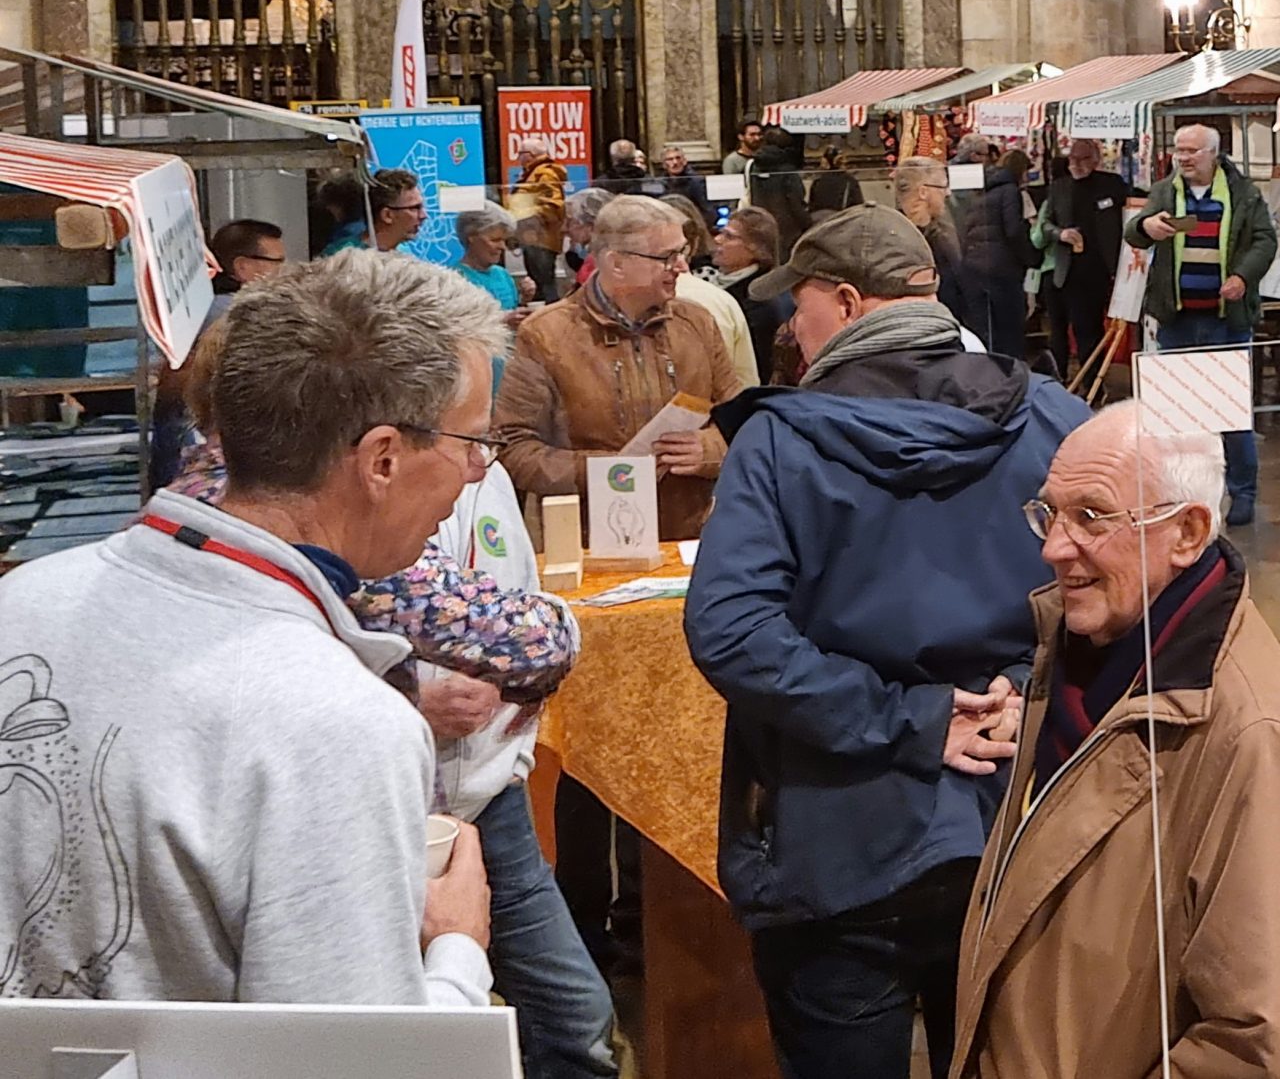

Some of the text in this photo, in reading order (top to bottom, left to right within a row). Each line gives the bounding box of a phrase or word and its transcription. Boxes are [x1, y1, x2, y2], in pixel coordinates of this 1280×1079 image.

[506, 102, 584, 131] TOT UW
[508, 131, 586, 161] DNST!
